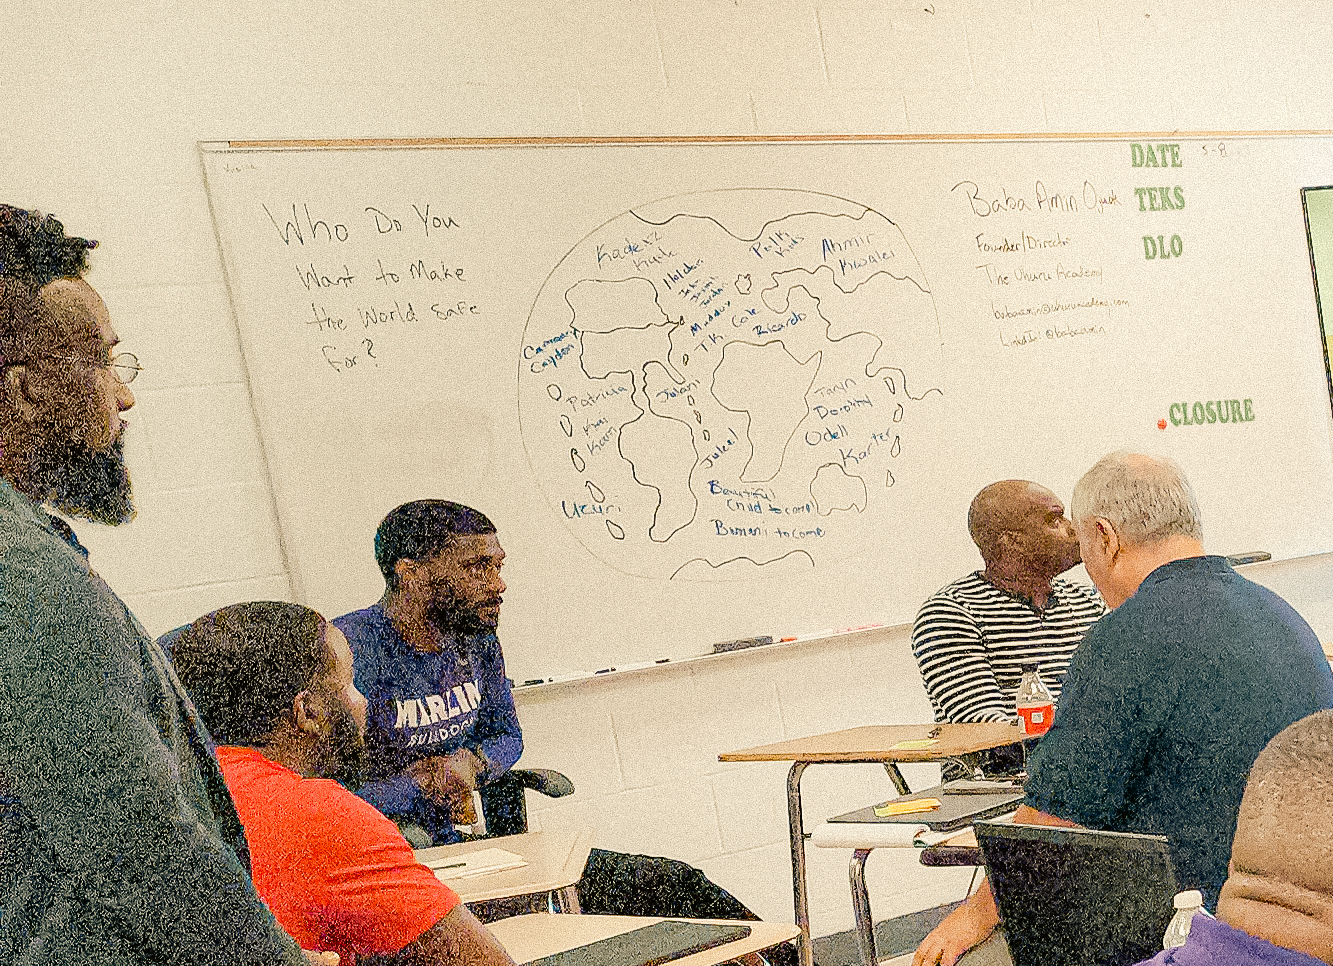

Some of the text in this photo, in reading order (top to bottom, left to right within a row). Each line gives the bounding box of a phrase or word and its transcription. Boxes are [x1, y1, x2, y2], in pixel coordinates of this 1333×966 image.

[1130, 143, 1182, 168] DATE
[951, 181, 1031, 217] Baba
[1036, 180, 1078, 212] Amin
[1134, 185, 1185, 211] TEKS
[262, 203, 460, 245] Who Do You
[1142, 235, 1183, 260] DLO
[296, 259, 466, 290] Want to Make
[975, 263, 1009, 285] The
[306, 303, 347, 331] the
[357, 301, 418, 328] World
[1168, 399, 1255, 426] CLOSURE
[805, 424, 848, 445] Odell
[394, 679, 481, 729] MARLIN
